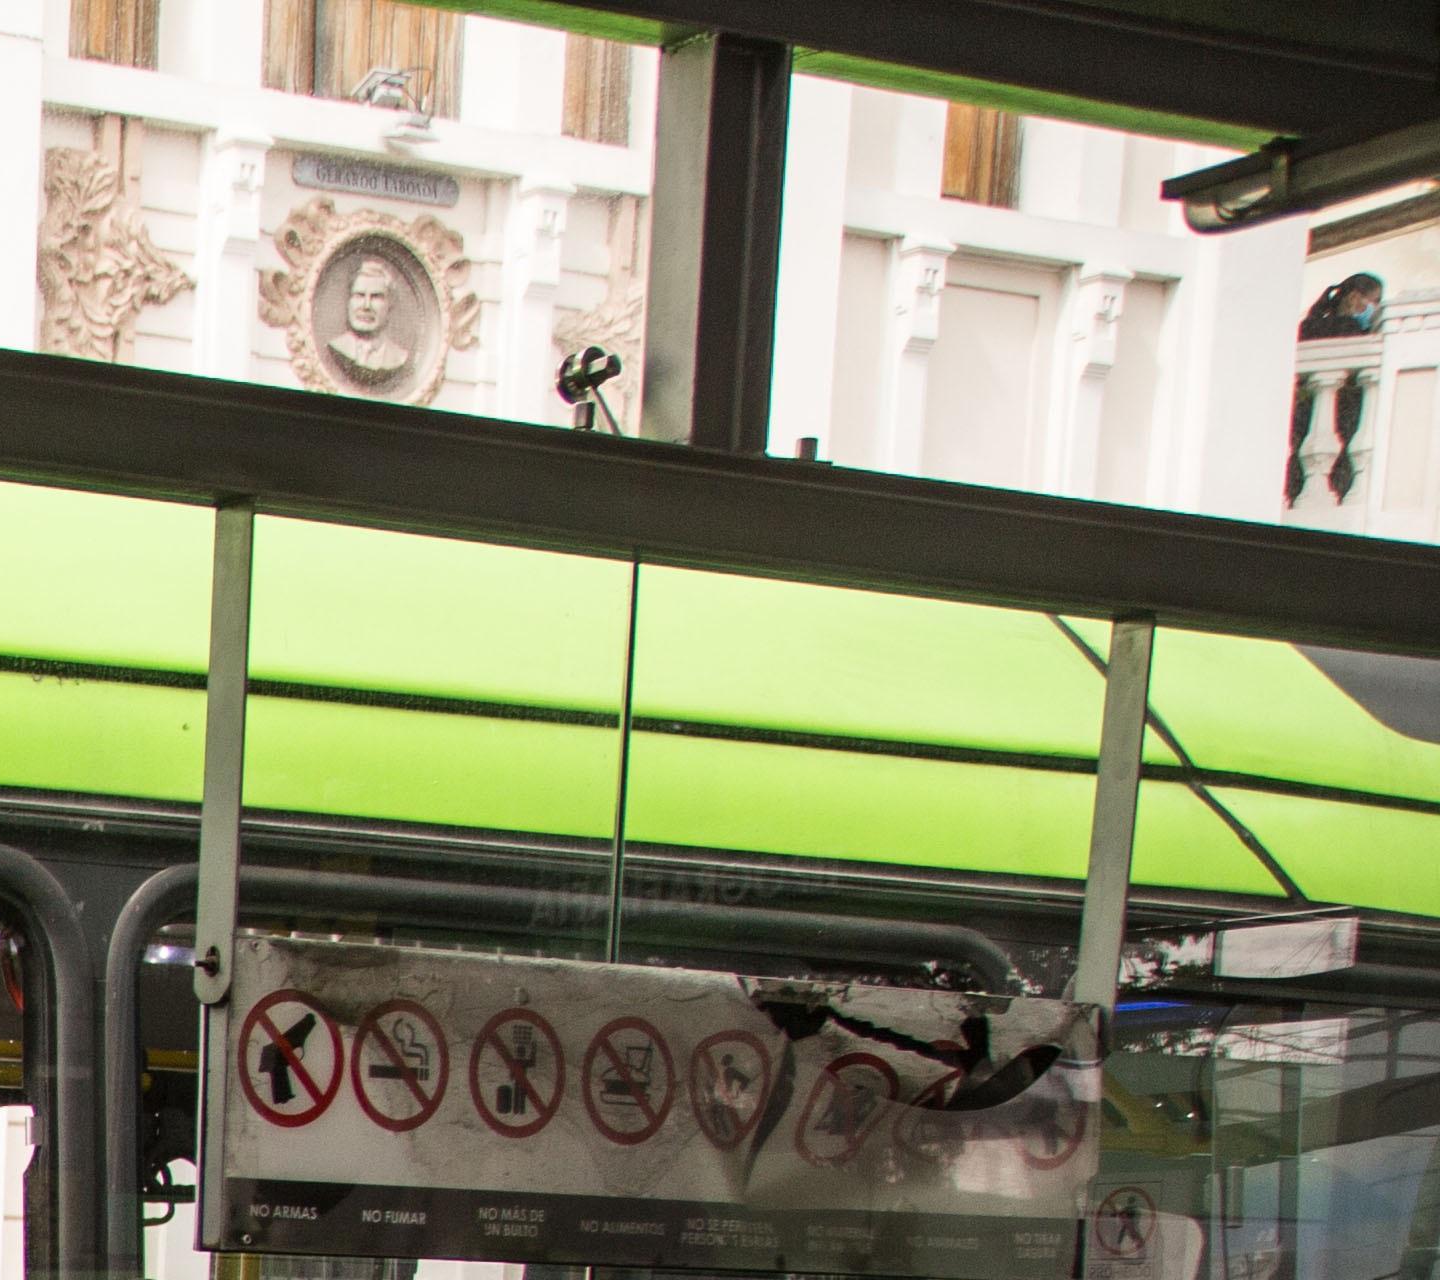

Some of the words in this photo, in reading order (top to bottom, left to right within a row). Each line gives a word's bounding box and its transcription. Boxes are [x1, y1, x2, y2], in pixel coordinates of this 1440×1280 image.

[249, 1204, 270, 1218] NO
[272, 1205, 318, 1221] ARMAS
[362, 1209, 381, 1223] NO
[384, 1211, 427, 1225] FUMAR
[479, 1207, 498, 1221] NO
